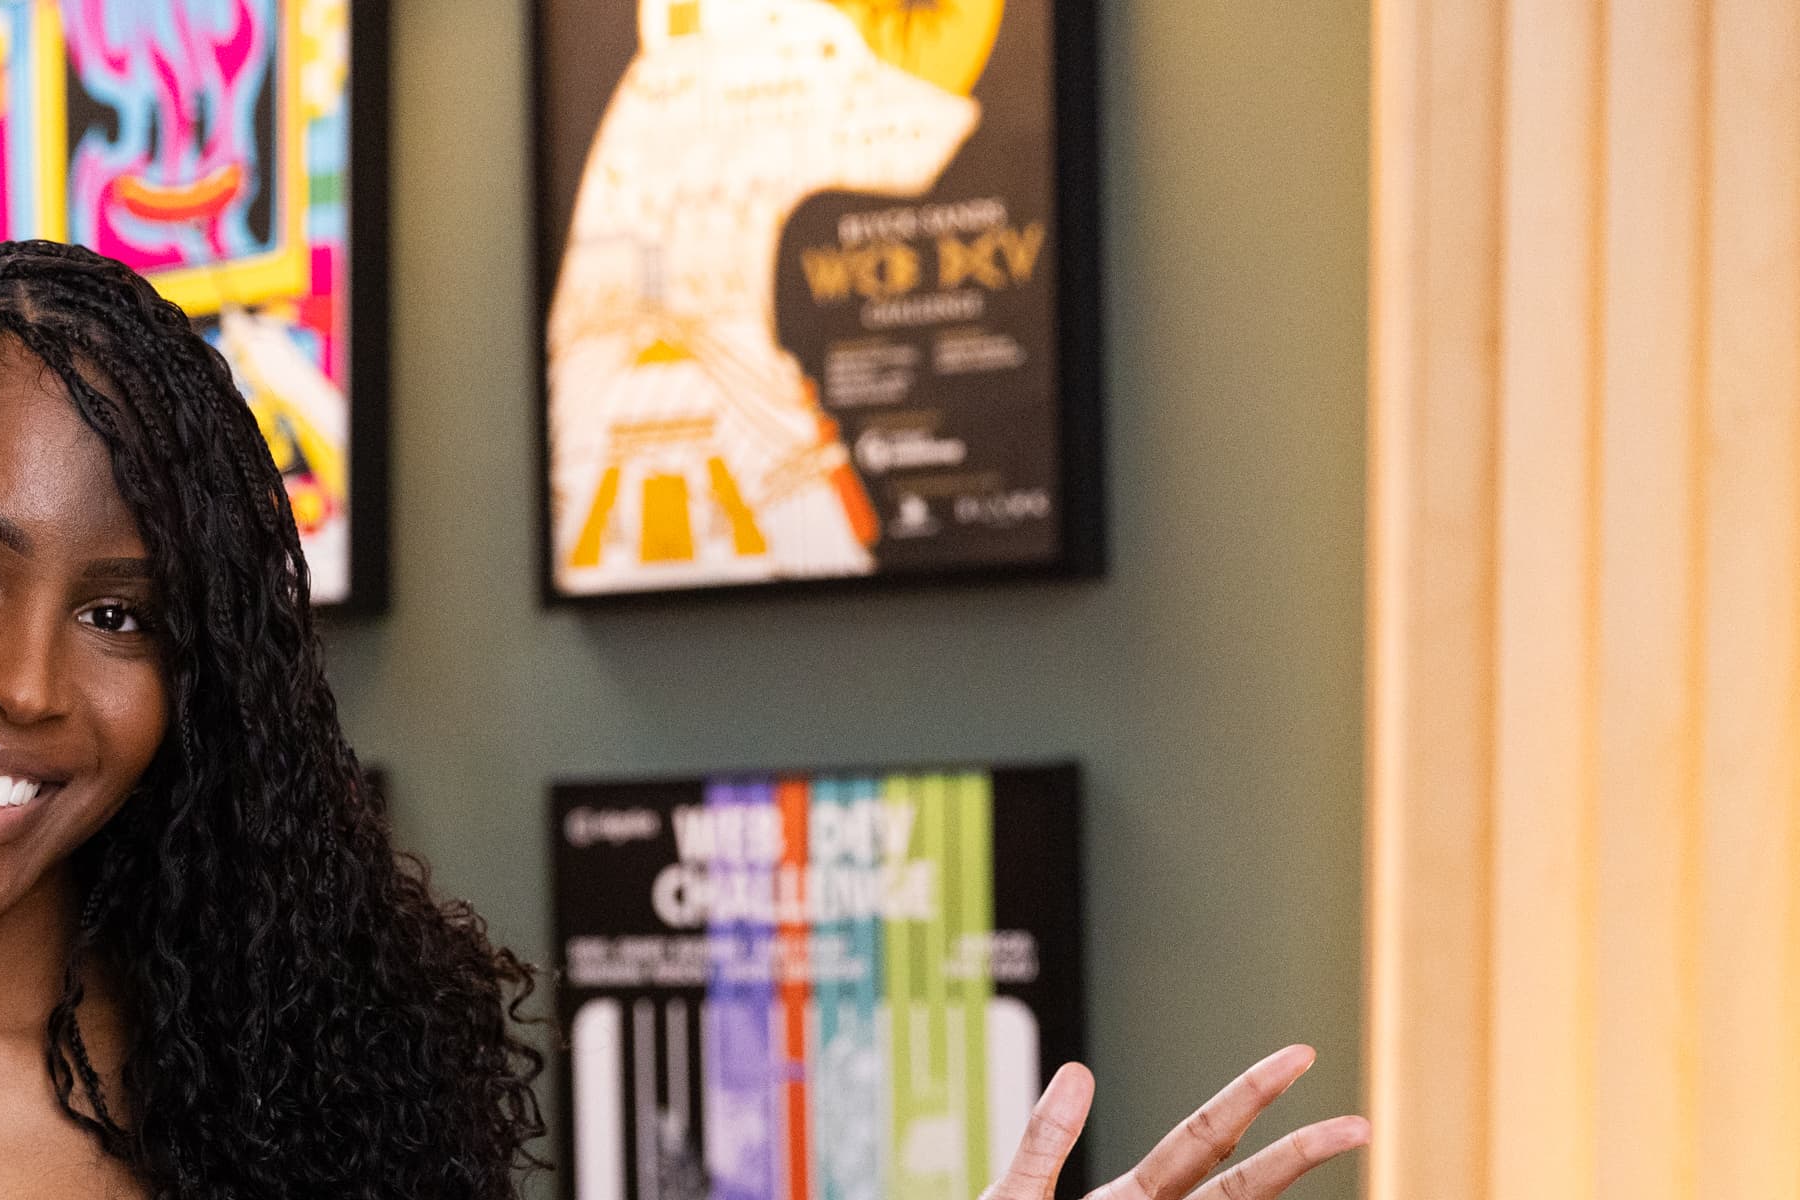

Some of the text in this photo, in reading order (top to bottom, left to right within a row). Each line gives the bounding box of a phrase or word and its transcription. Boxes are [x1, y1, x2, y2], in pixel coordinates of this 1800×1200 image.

[673, 799, 916, 863] WEB DEV
[654, 862, 937, 925] CHALLENGE
